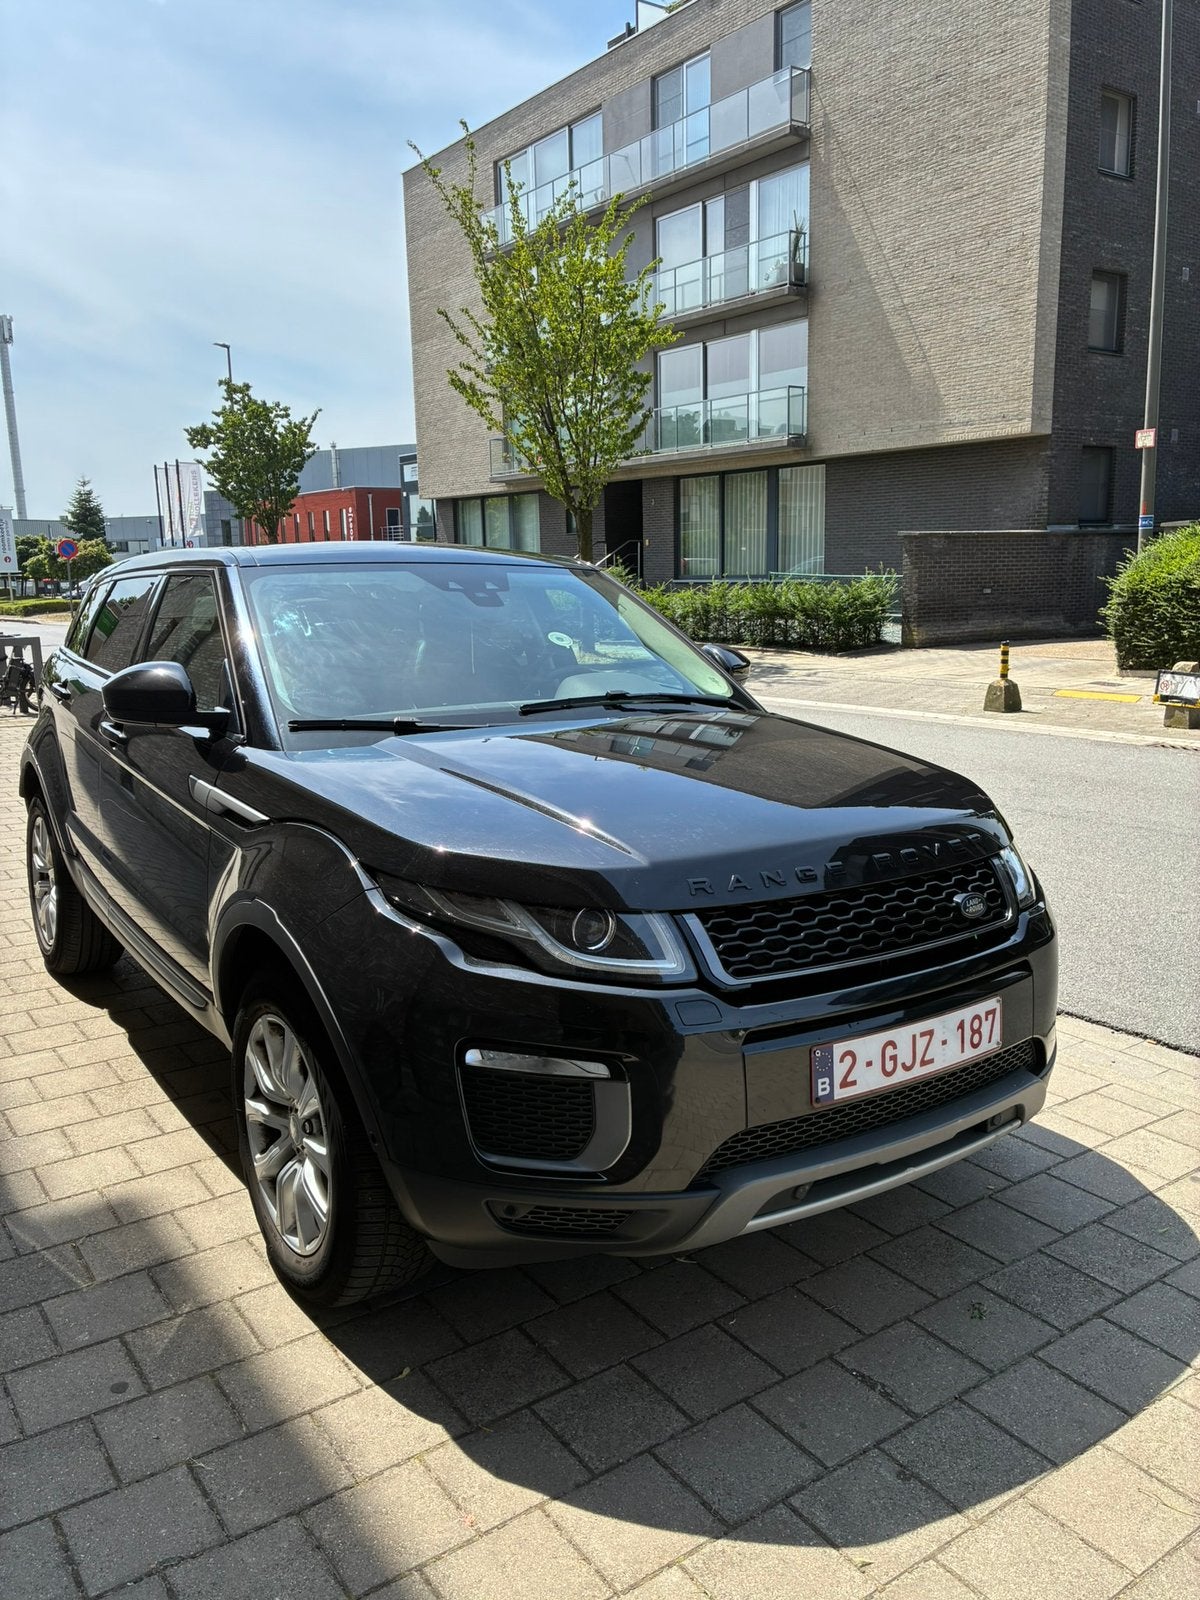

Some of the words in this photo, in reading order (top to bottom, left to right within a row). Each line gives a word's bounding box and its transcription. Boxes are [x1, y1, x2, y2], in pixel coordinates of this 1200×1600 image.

[686, 861, 847, 896] RANGE
[872, 833, 986, 871] ROVER
[839, 1008, 997, 1089] 2-GJZ-187
[817, 1077, 830, 1096] B
